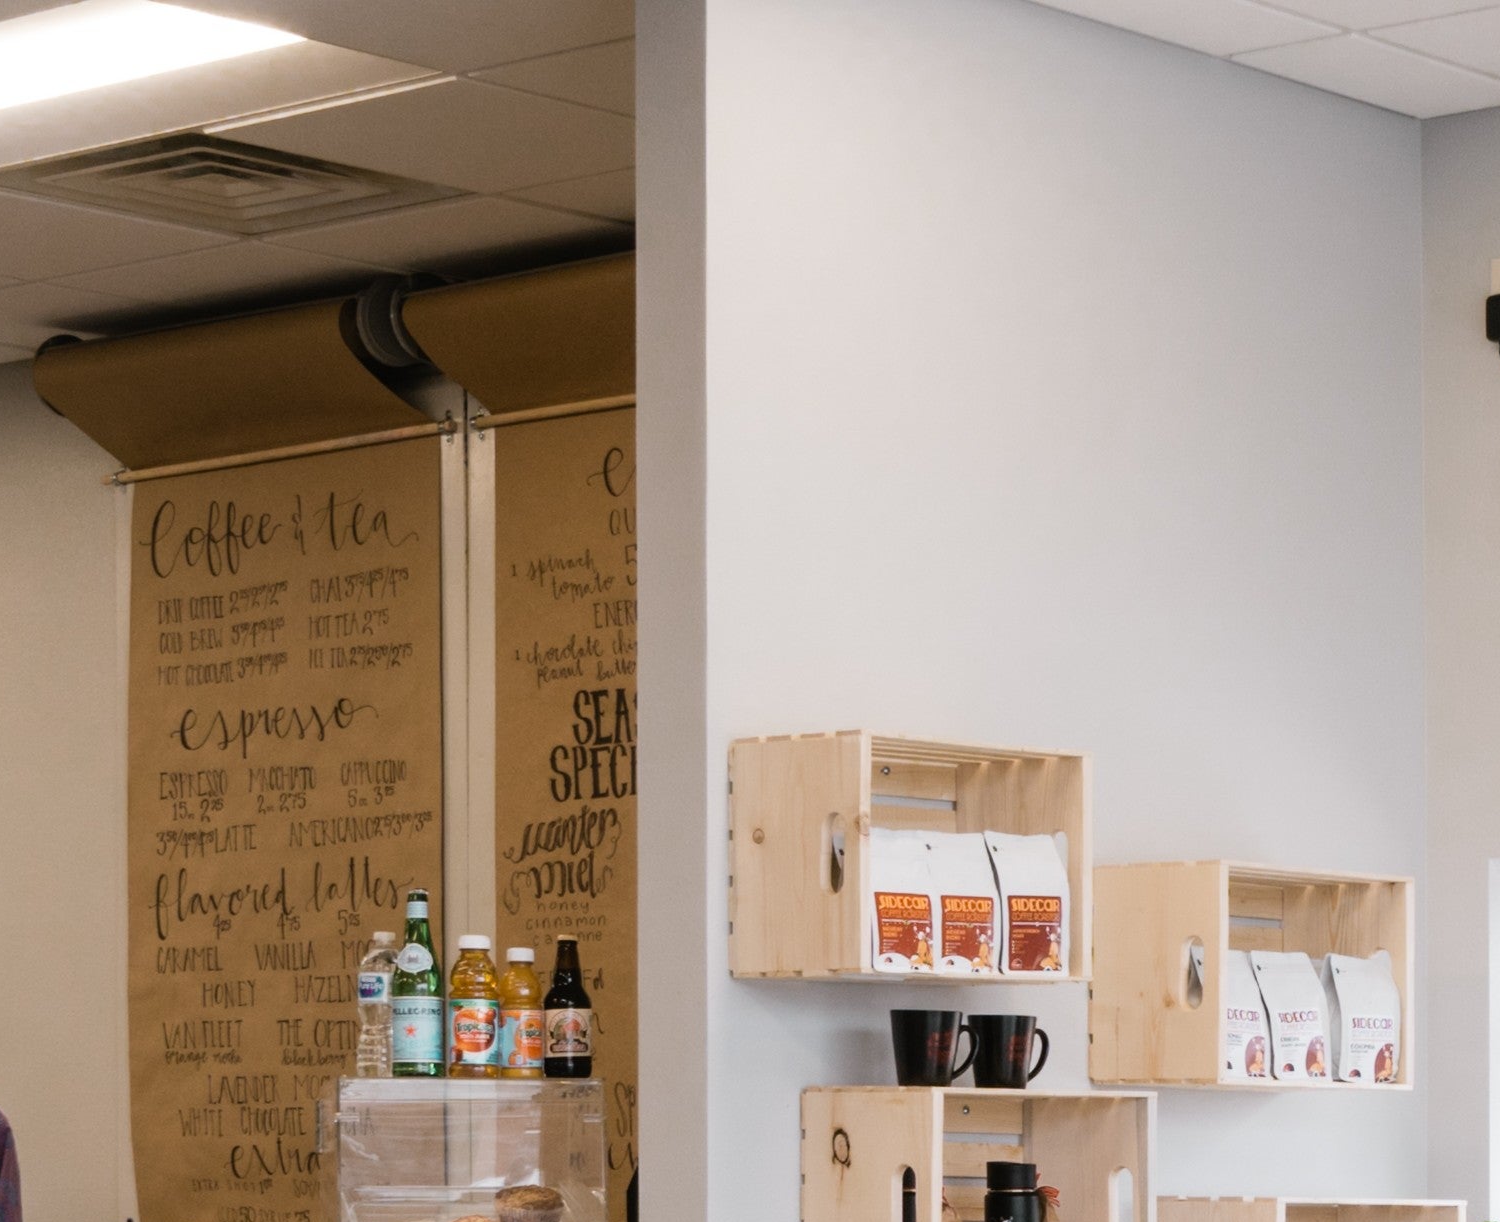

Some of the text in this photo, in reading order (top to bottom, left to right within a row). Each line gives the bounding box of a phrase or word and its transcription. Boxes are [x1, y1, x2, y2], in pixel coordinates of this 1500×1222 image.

[140, 500, 282, 578] Coffee
[312, 492, 419, 551] tea
[170, 697, 379, 760] espresso
[573, 688, 637, 745] SEA
[149, 856, 414, 941] flavored lattes
[536, 902, 590, 914] honey
[1011, 899, 1060, 912] SIDECAR
[525, 915, 607, 931] cinnamon
[156, 945, 224, 974] CARAMEL
[254, 941, 317, 971] VANILLA
[202, 979, 257, 1008] HONEY
[393, 1006, 441, 1016] ELLEGRINO
[1227, 1009, 1260, 1022] DECAR
[178, 1108, 224, 1137] WHITE
